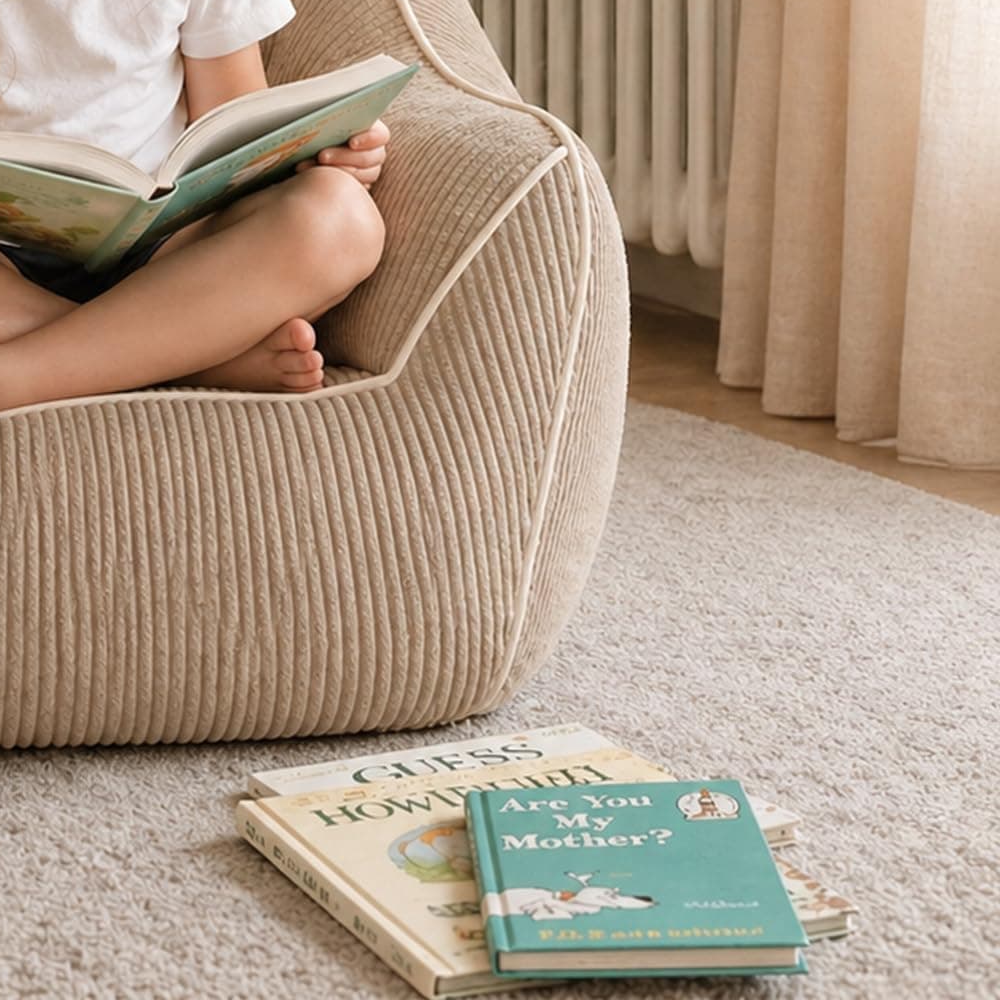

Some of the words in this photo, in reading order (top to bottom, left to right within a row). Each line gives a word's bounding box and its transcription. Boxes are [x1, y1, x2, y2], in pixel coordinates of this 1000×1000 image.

[352, 743, 544, 784] GUESS
[581, 794, 652, 809] You
[552, 813, 614, 831] My
[501, 828, 673, 850] Mother?
